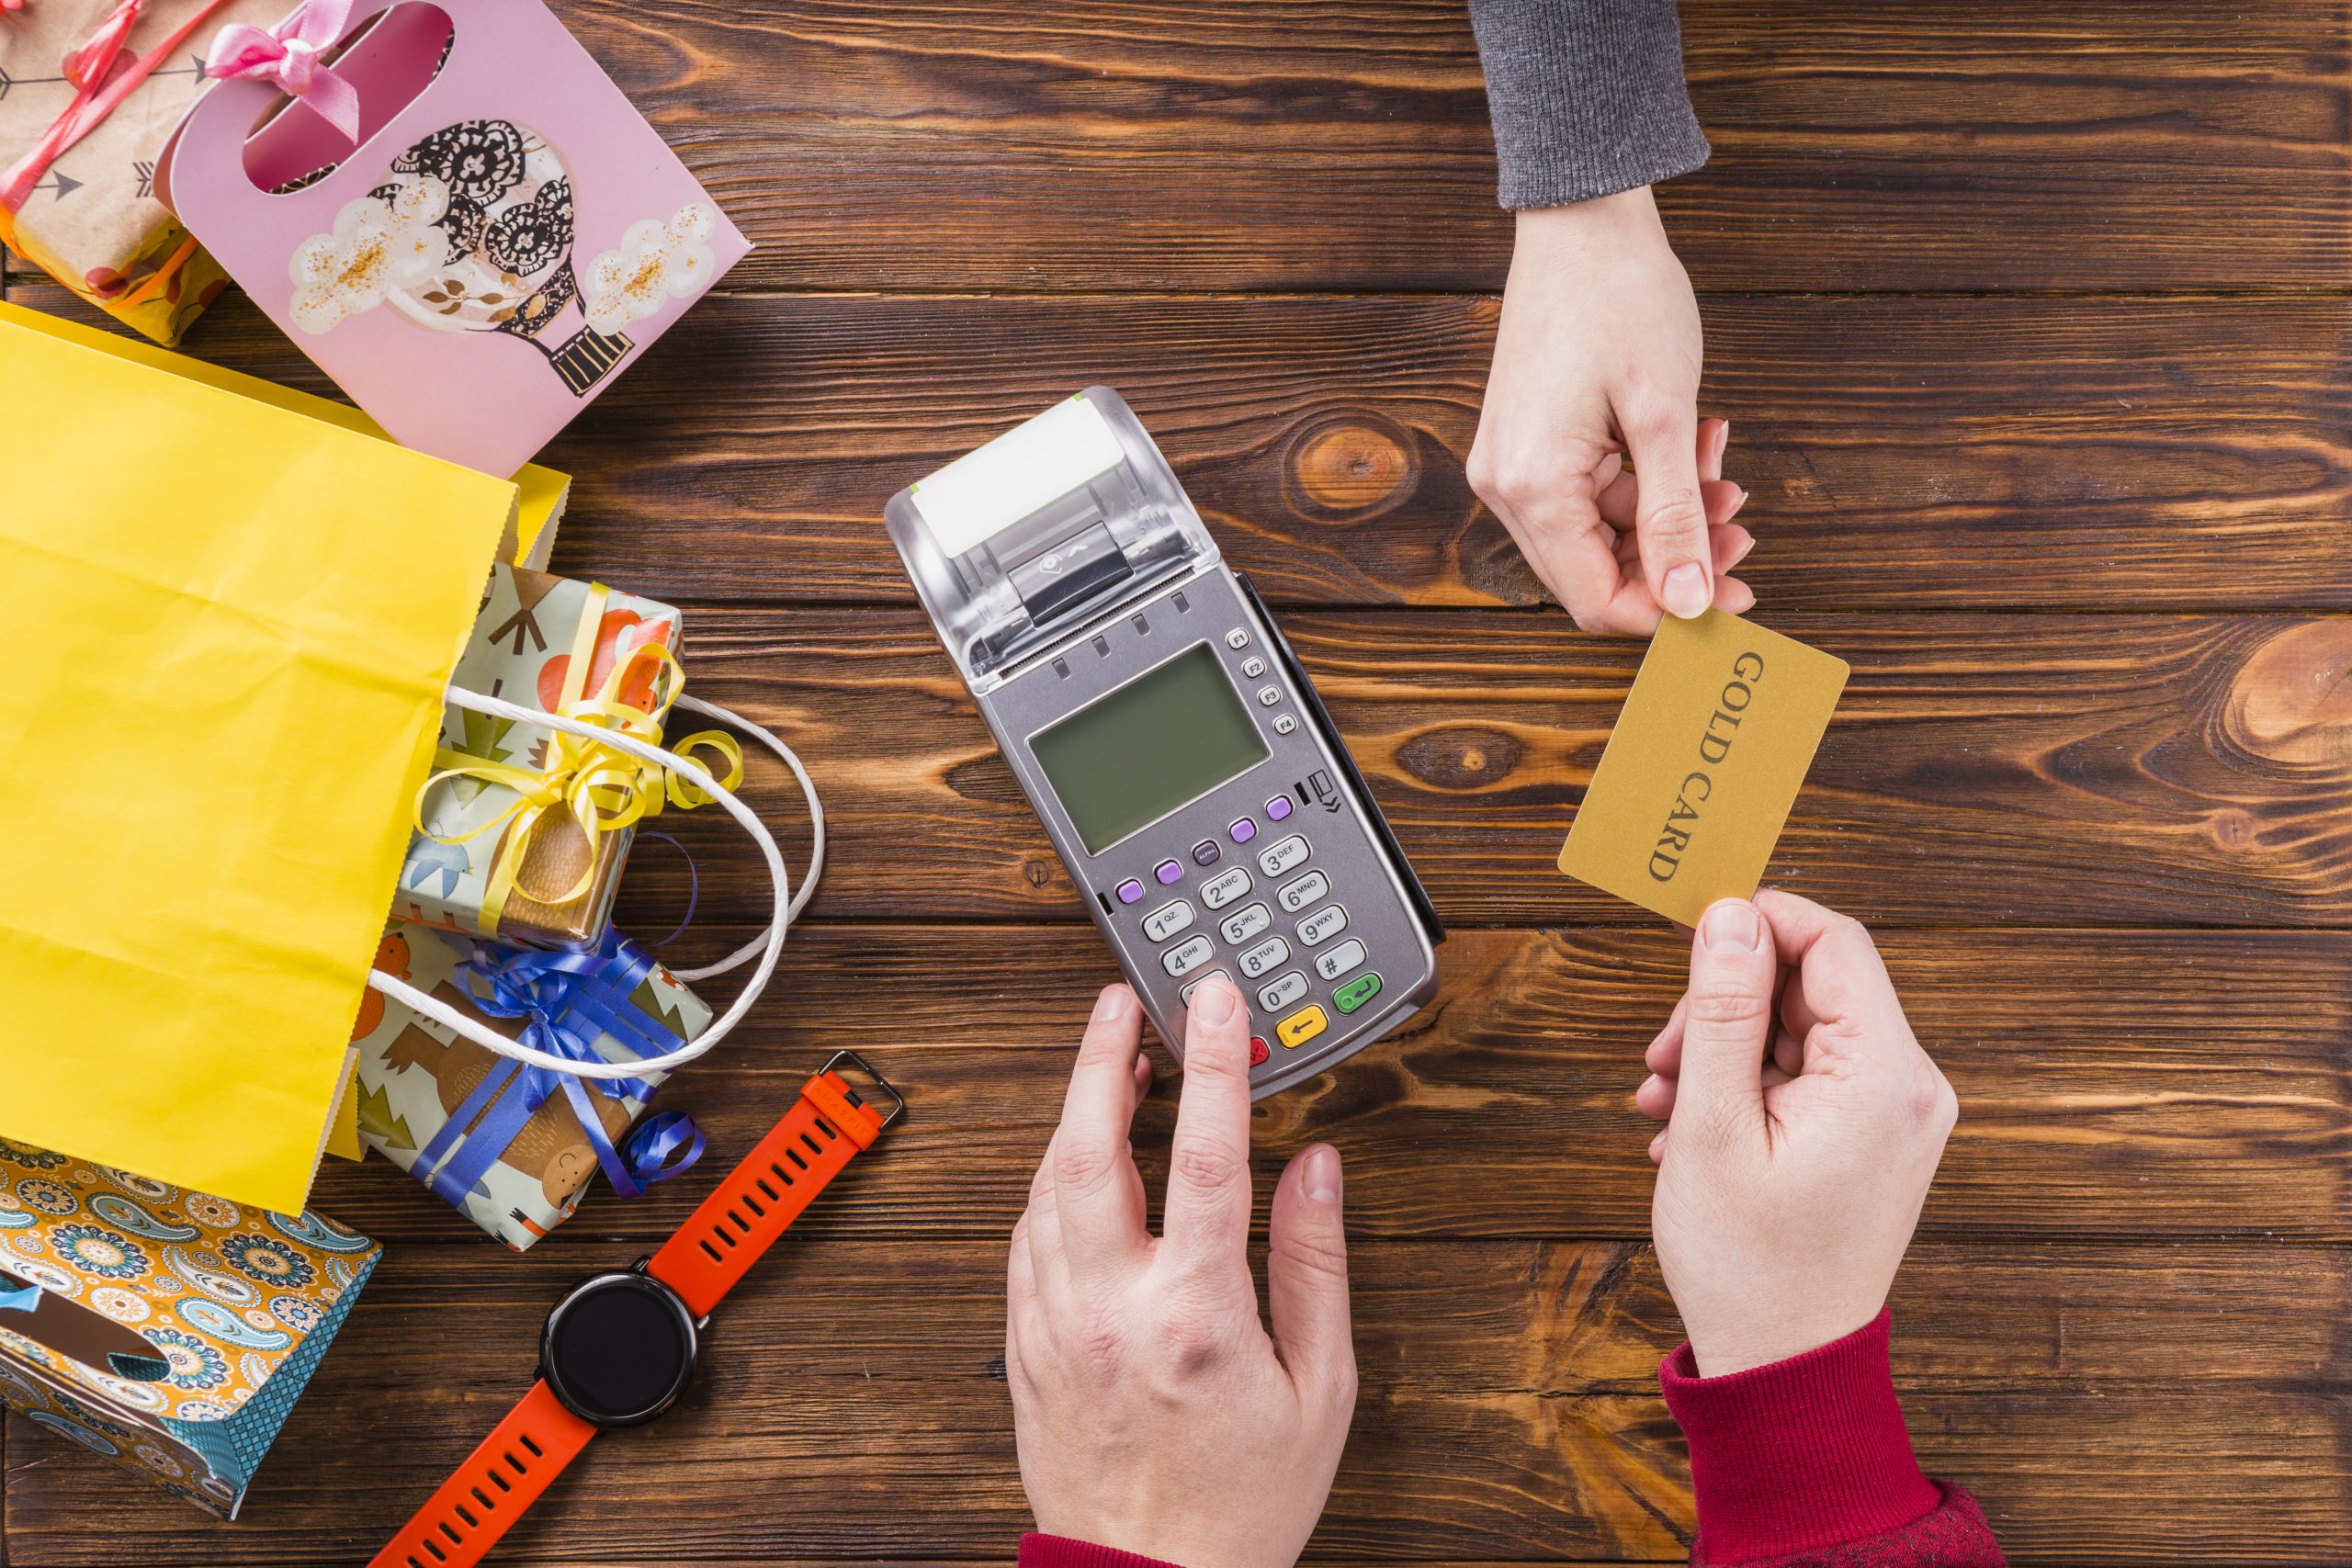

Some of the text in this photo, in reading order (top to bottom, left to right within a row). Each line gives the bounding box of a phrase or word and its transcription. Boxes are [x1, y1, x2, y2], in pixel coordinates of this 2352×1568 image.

[1233, 634, 1245, 645] F1
[1249, 662, 1261, 674] F2
[1264, 691, 1277, 703] F3
[1280, 719, 1292, 731] F4
[1648, 651, 1765, 883] GOLD CARD
[1199, 849, 1215, 860] ALPHA
[814, 1088, 867, 1137] AMAZFIT
